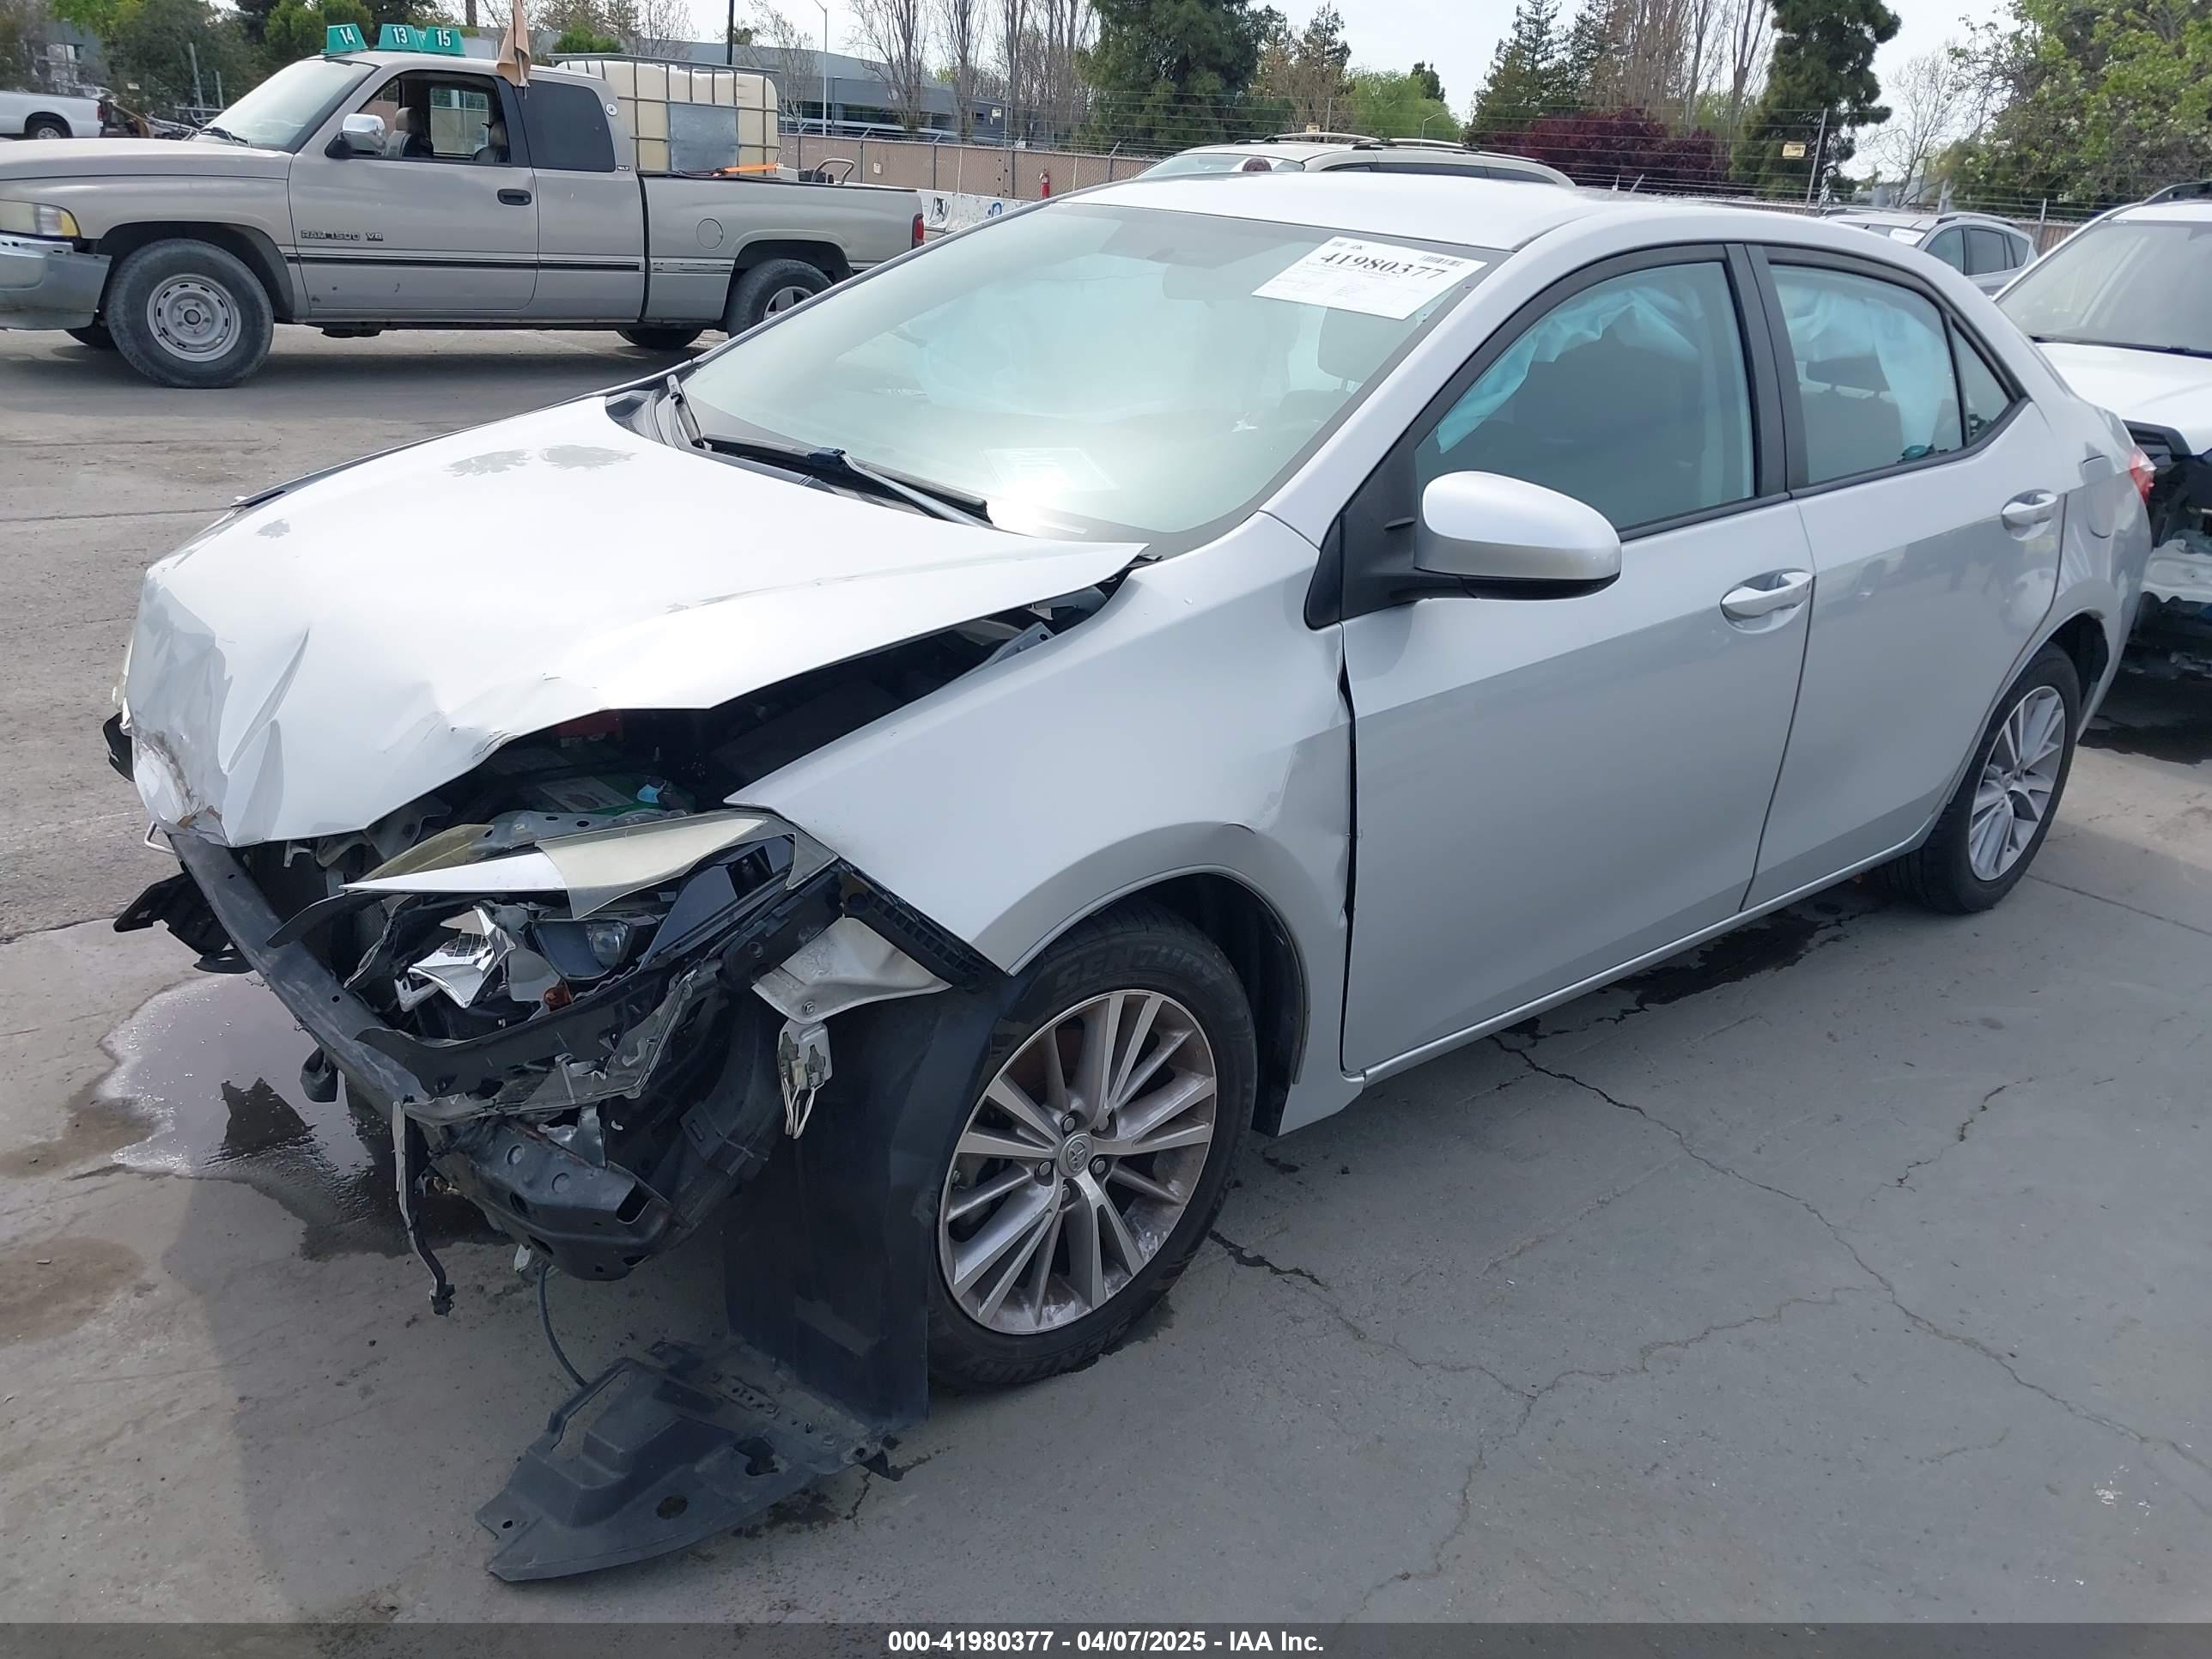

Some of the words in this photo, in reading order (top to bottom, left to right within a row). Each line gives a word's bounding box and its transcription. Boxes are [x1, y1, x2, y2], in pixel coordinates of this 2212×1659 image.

[339, 27, 356, 45] 14
[392, 27, 408, 44] 13
[436, 29, 451, 47] 15
[301, 229, 327, 240] RAM
[330, 231, 361, 241] 1500
[1320, 252, 1450, 280] 41980377
